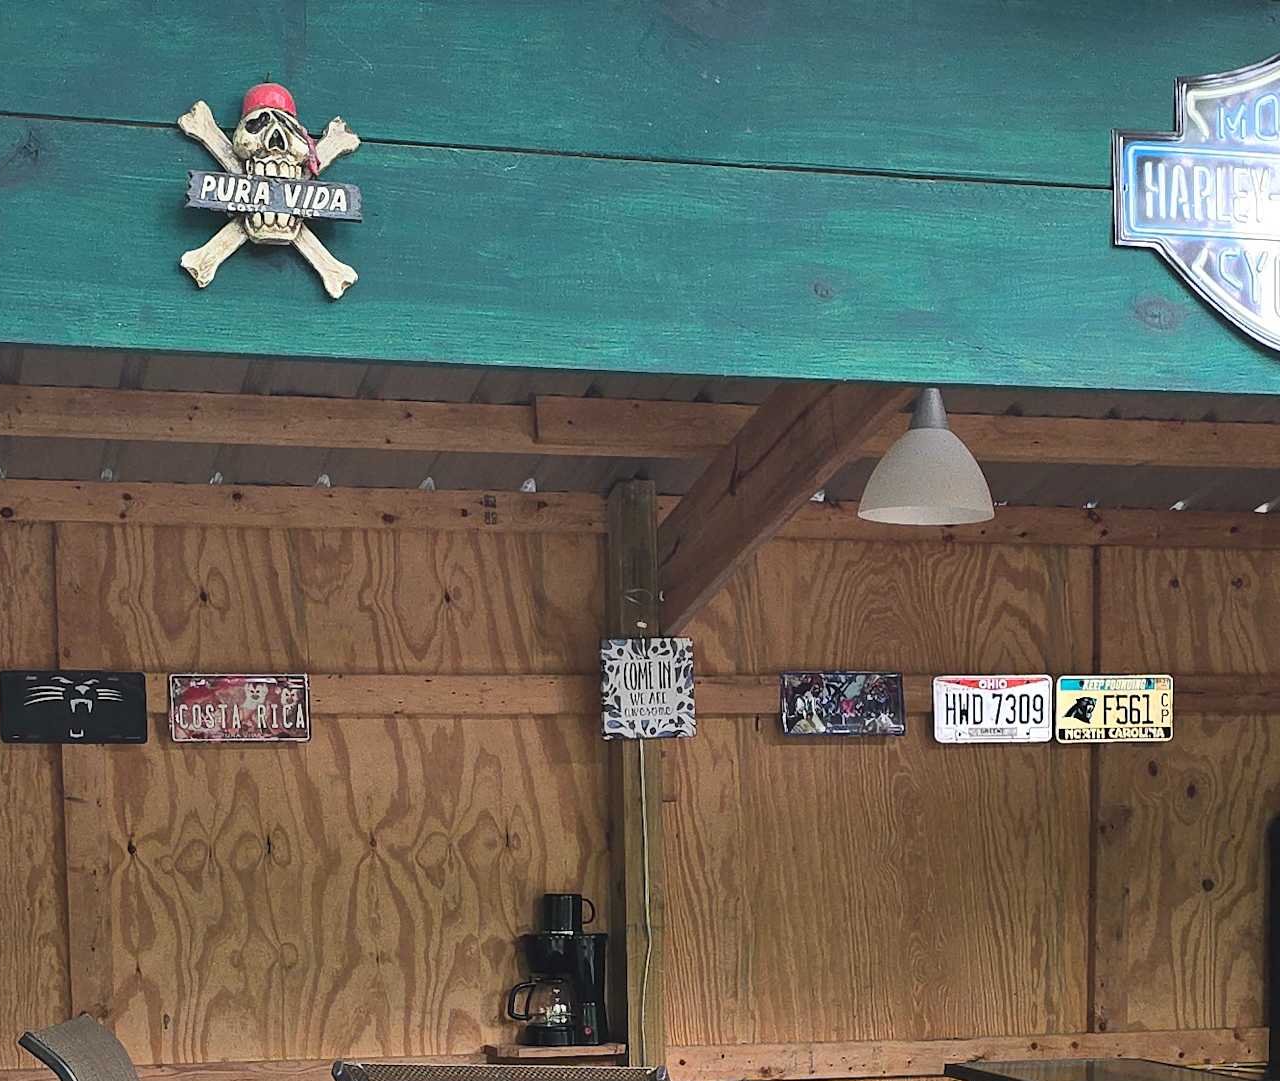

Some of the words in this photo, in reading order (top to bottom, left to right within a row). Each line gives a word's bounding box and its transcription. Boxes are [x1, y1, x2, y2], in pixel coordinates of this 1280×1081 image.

[200, 174, 270, 206] PURA
[283, 182, 348, 213] VIDA
[227, 202, 267, 213] COSTA
[623, 661, 654, 691] COME
[658, 660, 671, 690] IN
[978, 679, 1008, 689] OHIO
[1083, 679, 1104, 690] KEEP
[630, 691, 644, 706] WE
[648, 691, 666, 705] ARE
[945, 693, 983, 725] HWD
[992, 693, 1044, 725] 7309
[179, 703, 242, 730] COSTA
[257, 703, 305, 729] RICA
[1103, 694, 1154, 725] F561
[1064, 728, 1105, 740] NORTH
[1108, 727, 1166, 739] CAROLINA
